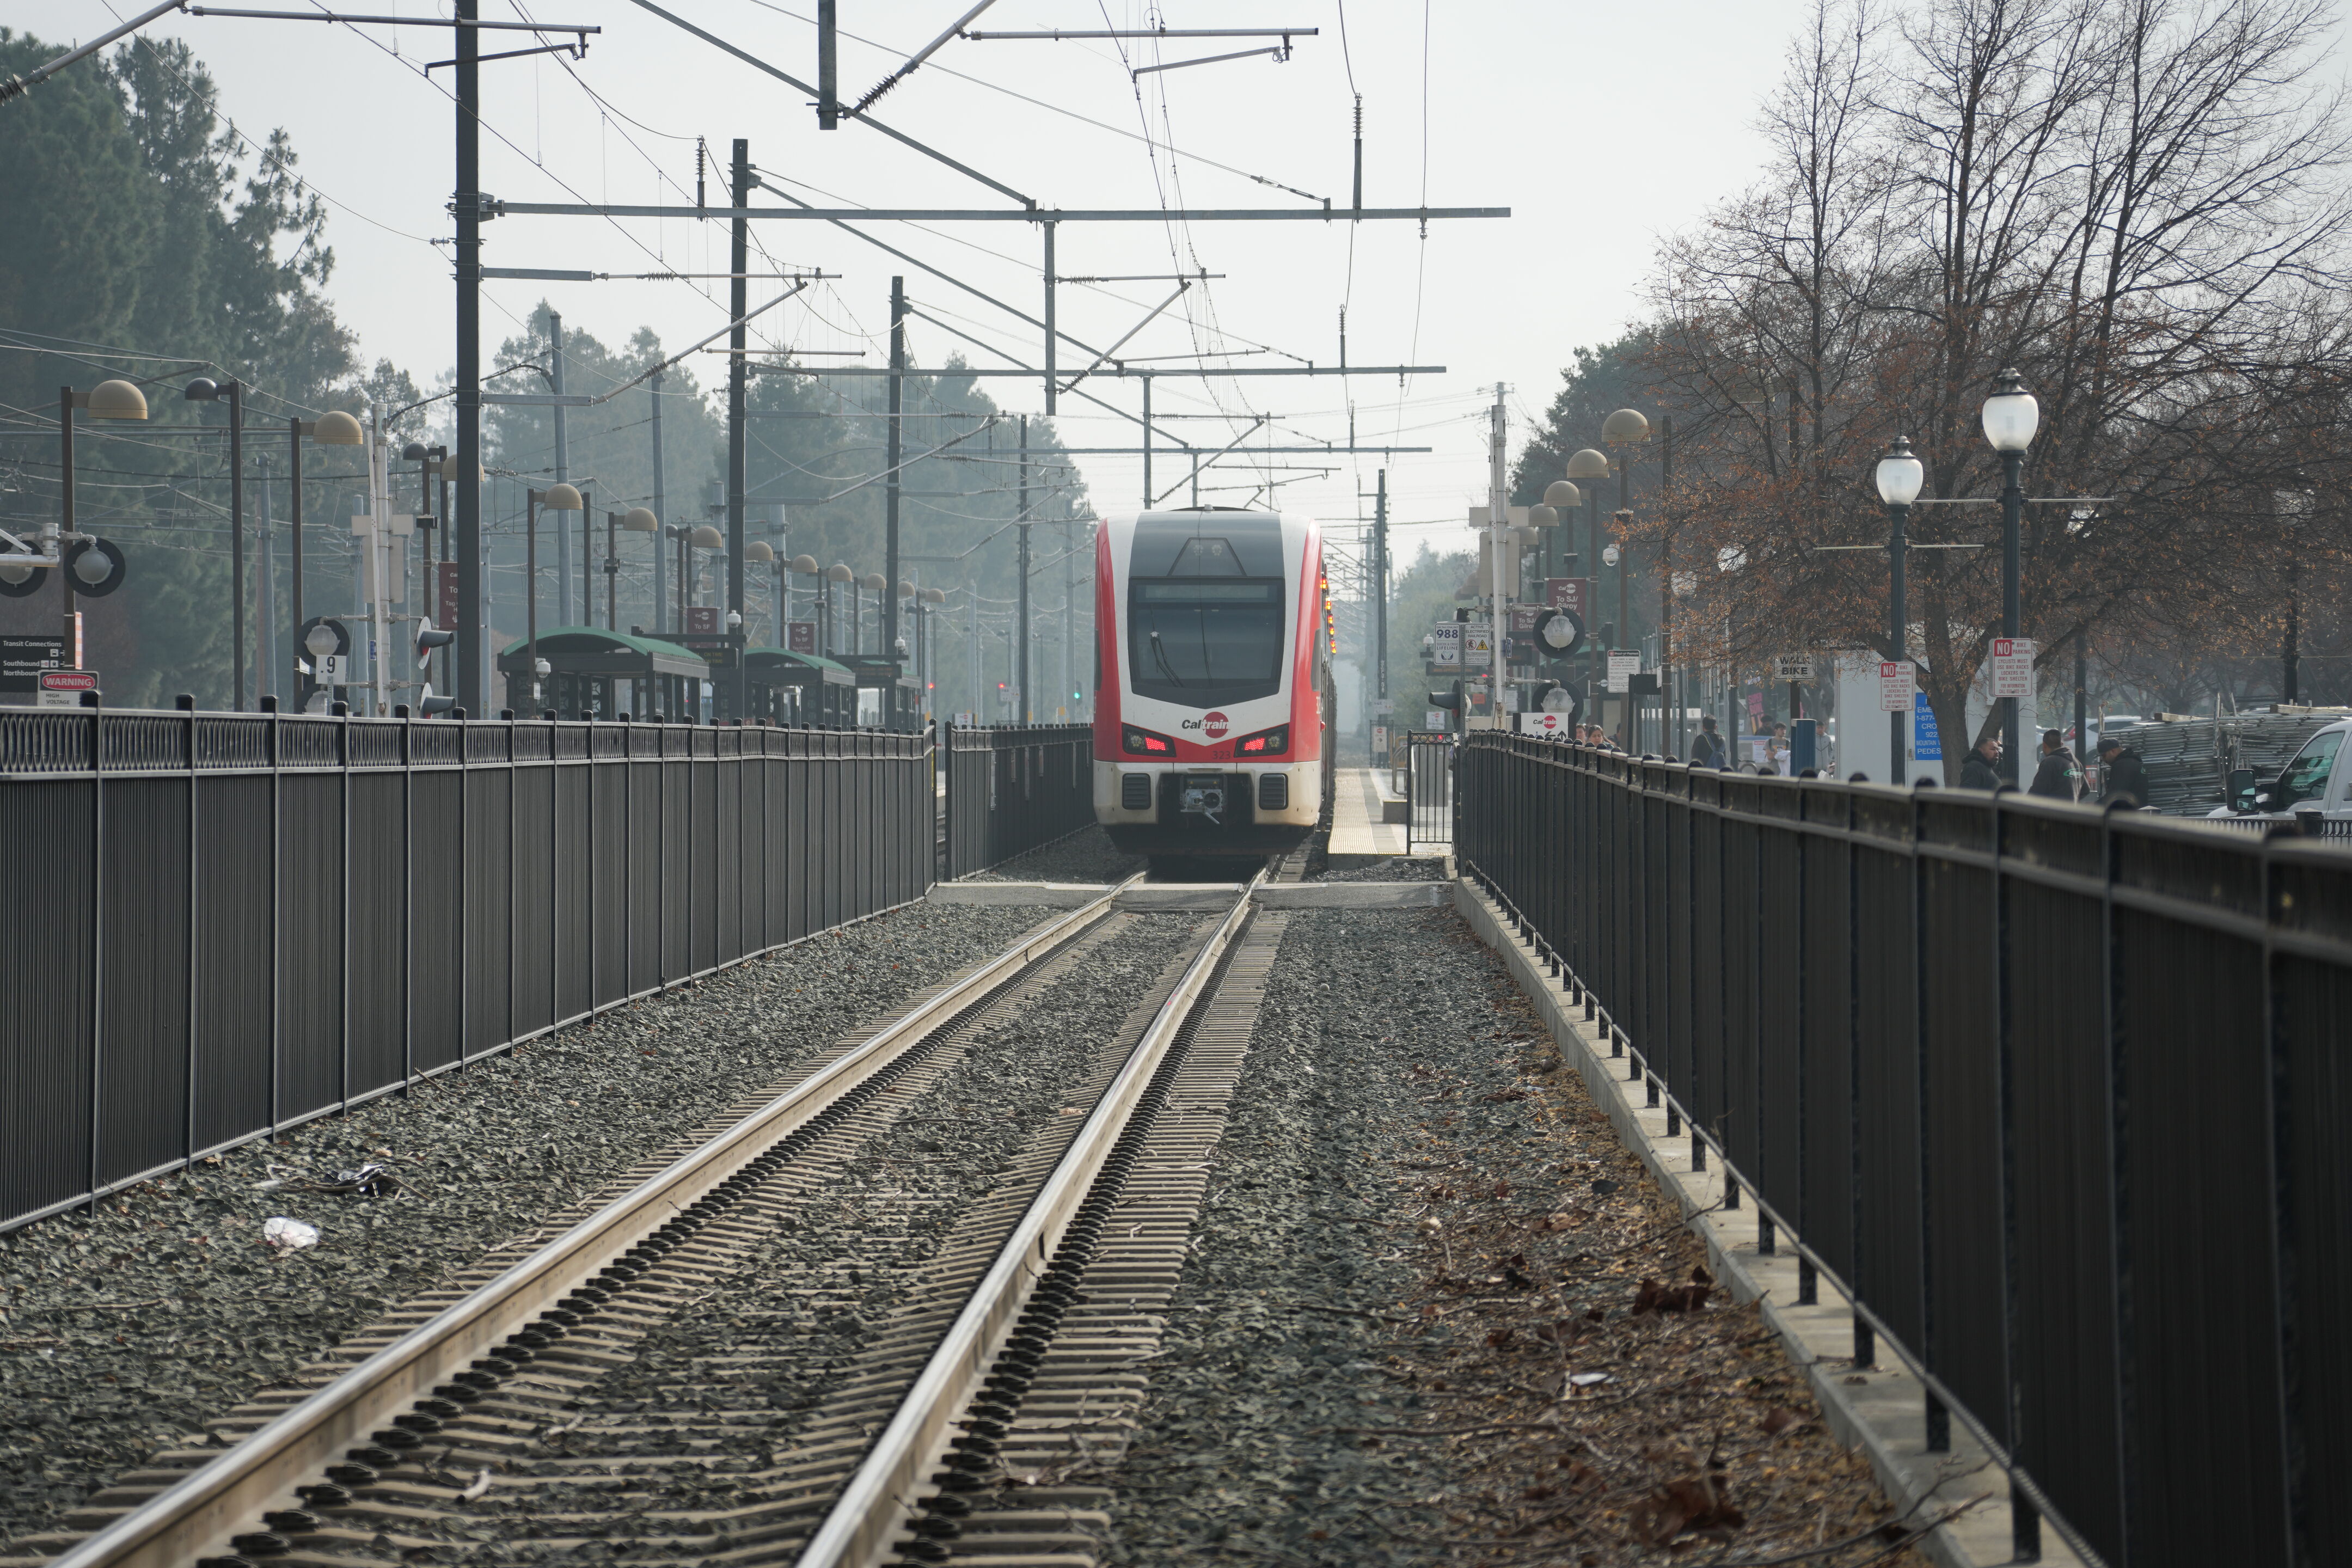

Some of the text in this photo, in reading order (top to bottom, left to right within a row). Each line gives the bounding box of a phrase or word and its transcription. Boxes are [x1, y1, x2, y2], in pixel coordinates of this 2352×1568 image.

[1436, 629, 1459, 639] 988
[1996, 642, 2010, 654] NO
[1781, 667, 1808, 675] BIKE
[1883, 665, 1894, 676] NO
[45, 677, 92, 687] WARNING
[1181, 719, 1229, 730] Caltrain
[1212, 751, 1230, 759] 323
